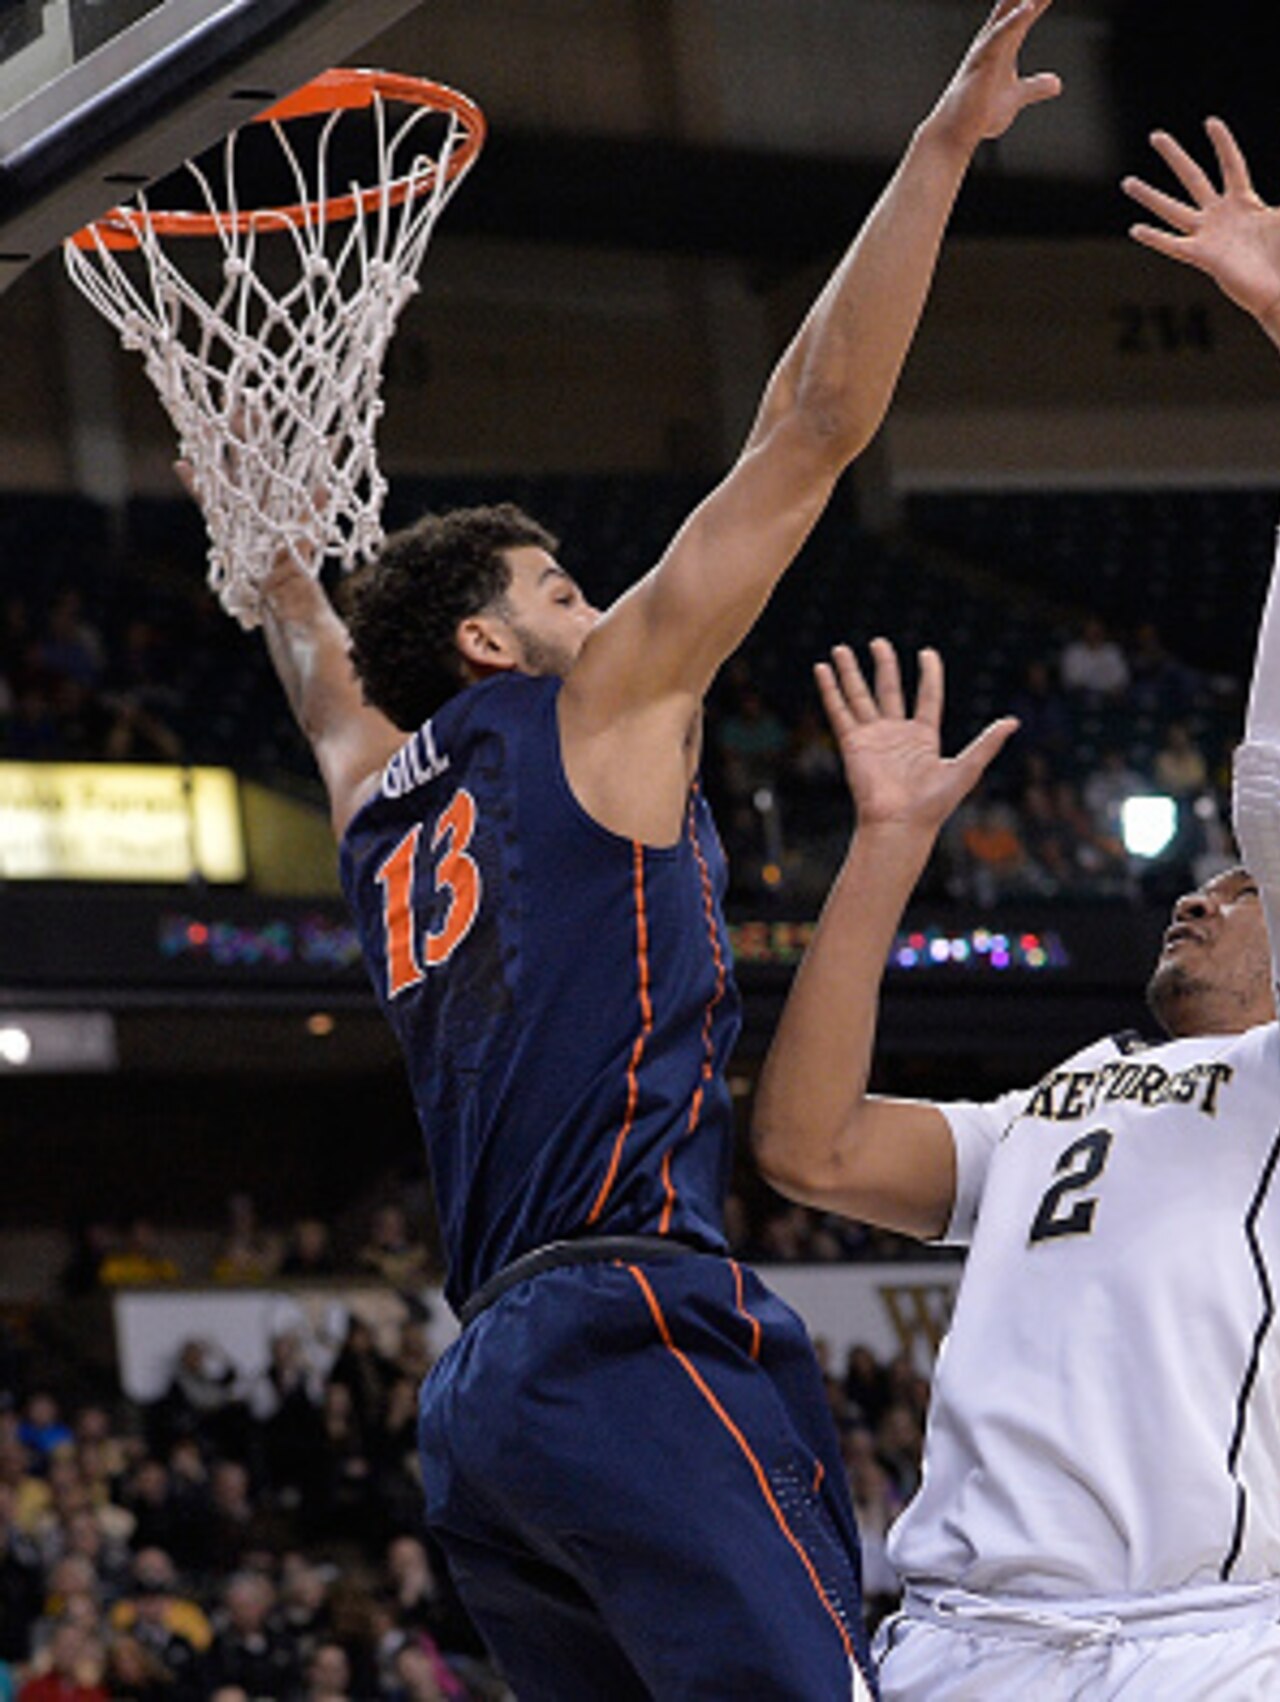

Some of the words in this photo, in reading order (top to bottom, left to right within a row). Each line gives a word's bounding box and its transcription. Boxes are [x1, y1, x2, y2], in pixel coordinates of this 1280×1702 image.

[382, 718, 449, 799] GILL
[374, 787, 480, 1000] 13
[1026, 1128, 1113, 1250] 2
